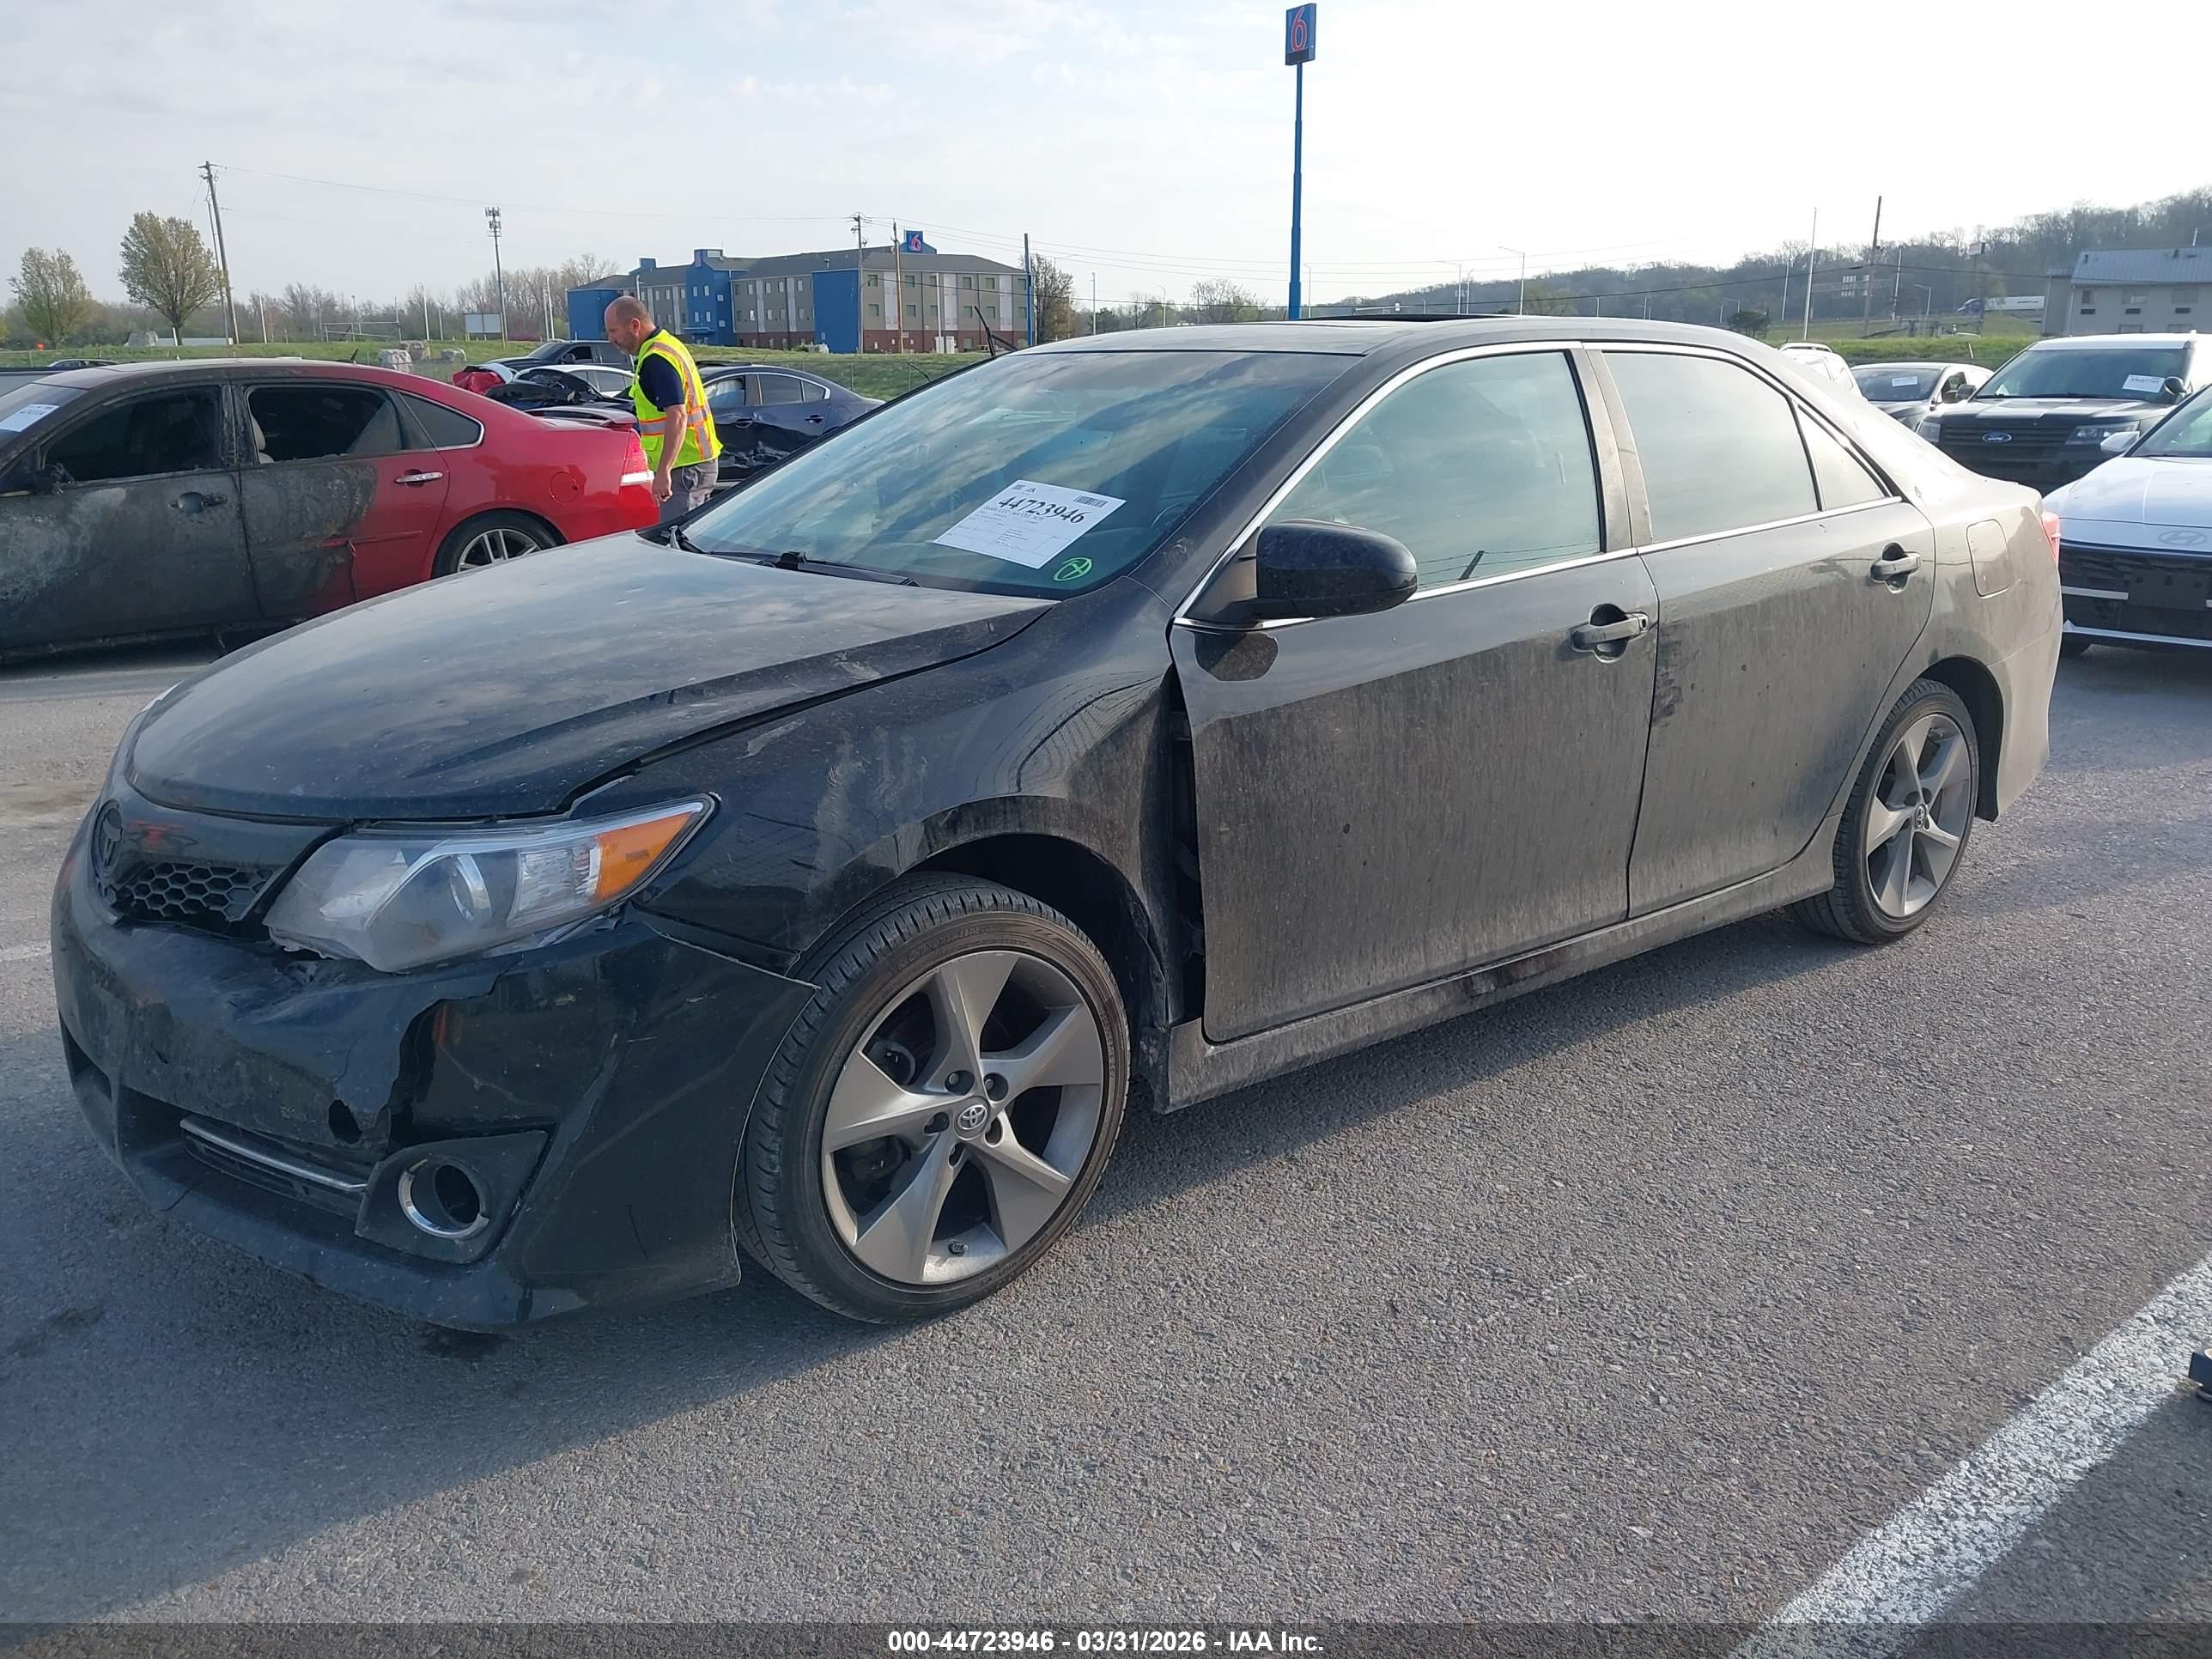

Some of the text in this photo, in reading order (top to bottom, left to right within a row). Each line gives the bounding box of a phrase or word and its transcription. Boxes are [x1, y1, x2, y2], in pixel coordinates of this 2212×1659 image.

[1291, 7, 1307, 52] 6
[911, 234, 921, 251] 6
[999, 496, 1091, 523] 44723946
